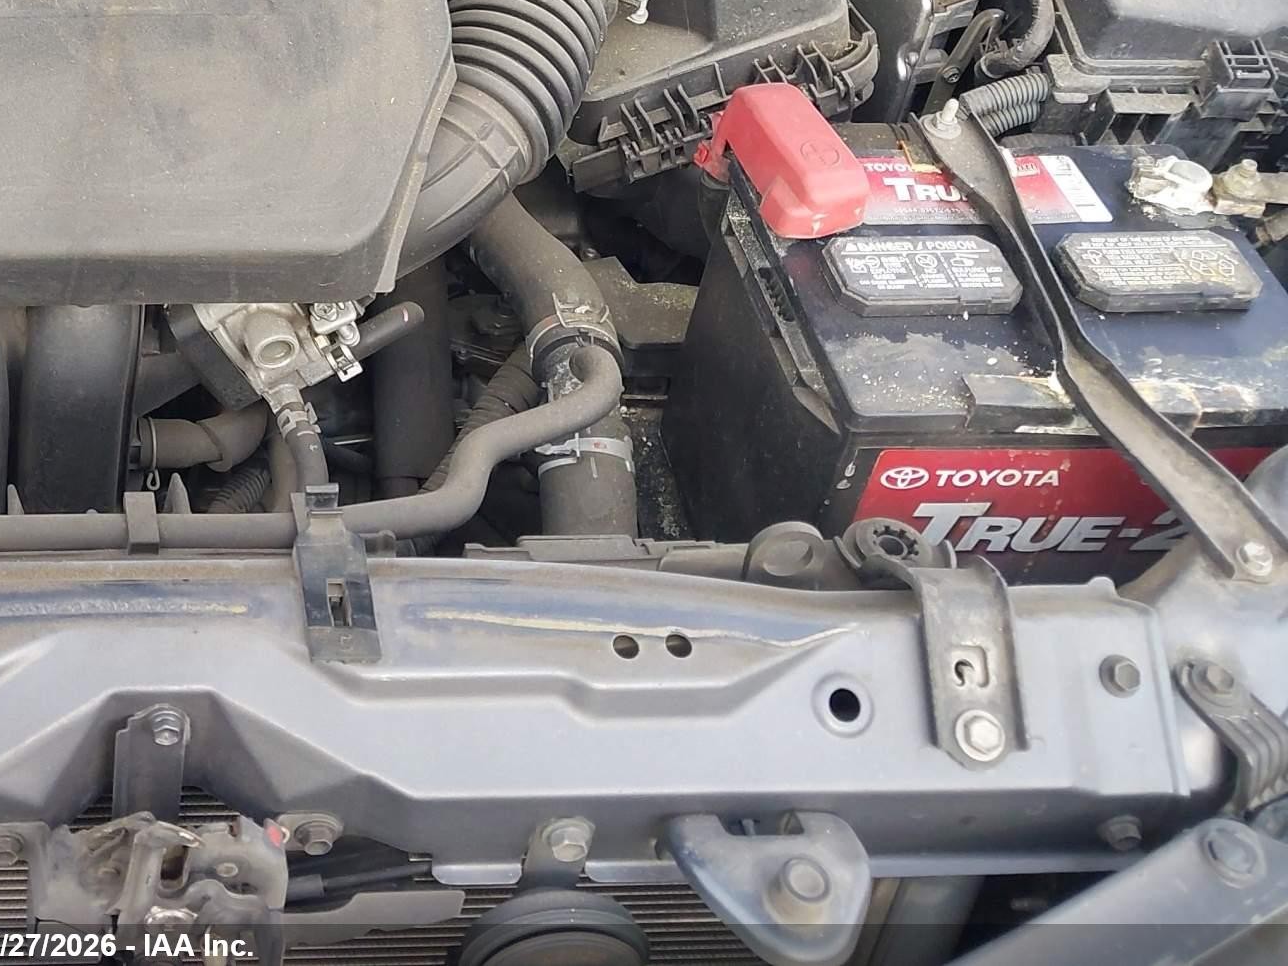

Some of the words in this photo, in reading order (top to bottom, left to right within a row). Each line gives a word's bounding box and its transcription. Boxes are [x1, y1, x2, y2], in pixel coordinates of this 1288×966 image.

[857, 241, 913, 251] DANGER
[926, 240, 977, 251] POISON
[936, 469, 1059, 487] TOYOTA
